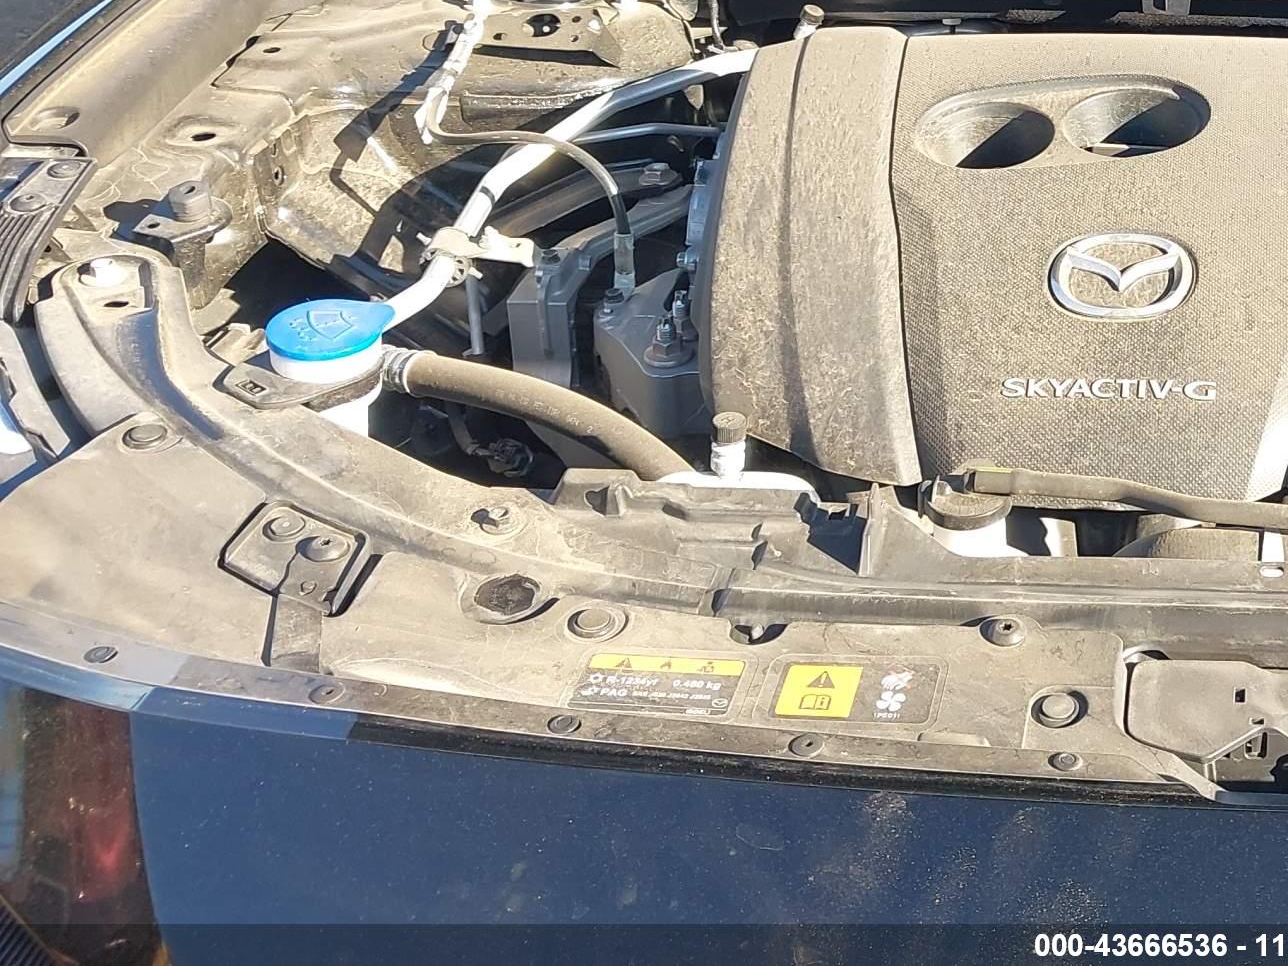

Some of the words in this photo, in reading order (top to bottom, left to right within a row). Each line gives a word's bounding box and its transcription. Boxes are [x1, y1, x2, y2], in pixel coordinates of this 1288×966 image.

[1001, 377, 1218, 402] SKYACTIV-G
[706, 680, 722, 691] kg
[599, 688, 628, 697] PAG
